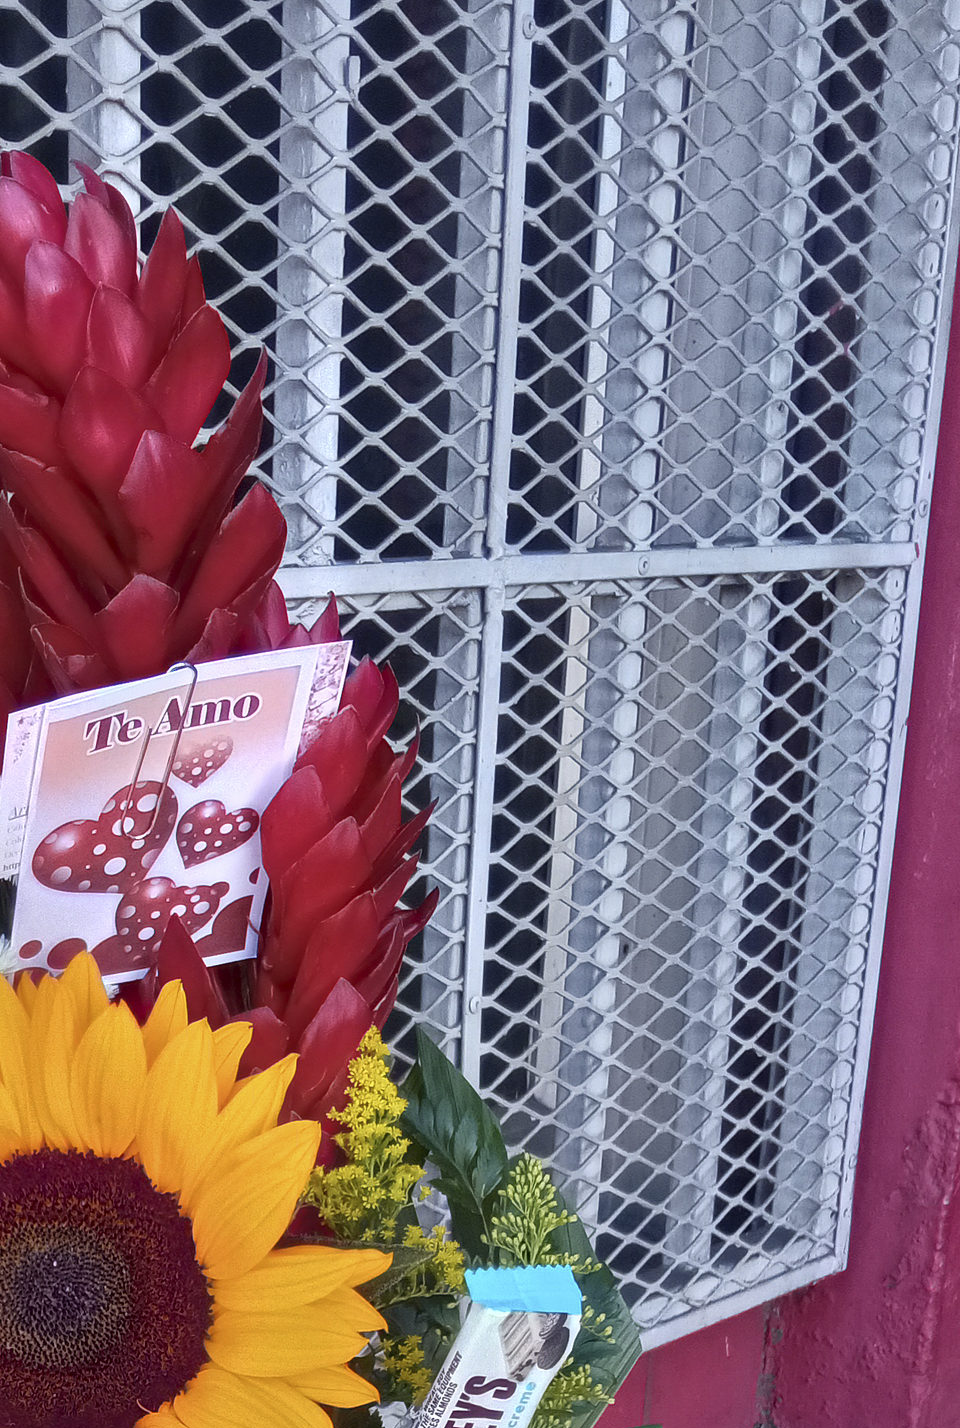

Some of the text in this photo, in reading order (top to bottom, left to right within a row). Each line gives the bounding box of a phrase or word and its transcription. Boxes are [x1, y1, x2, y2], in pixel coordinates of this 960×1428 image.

[85, 694, 260, 753] Te Amo
[436, 1381, 458, 1418] ALMONDS
[508, 1381, 537, 1428] creme
